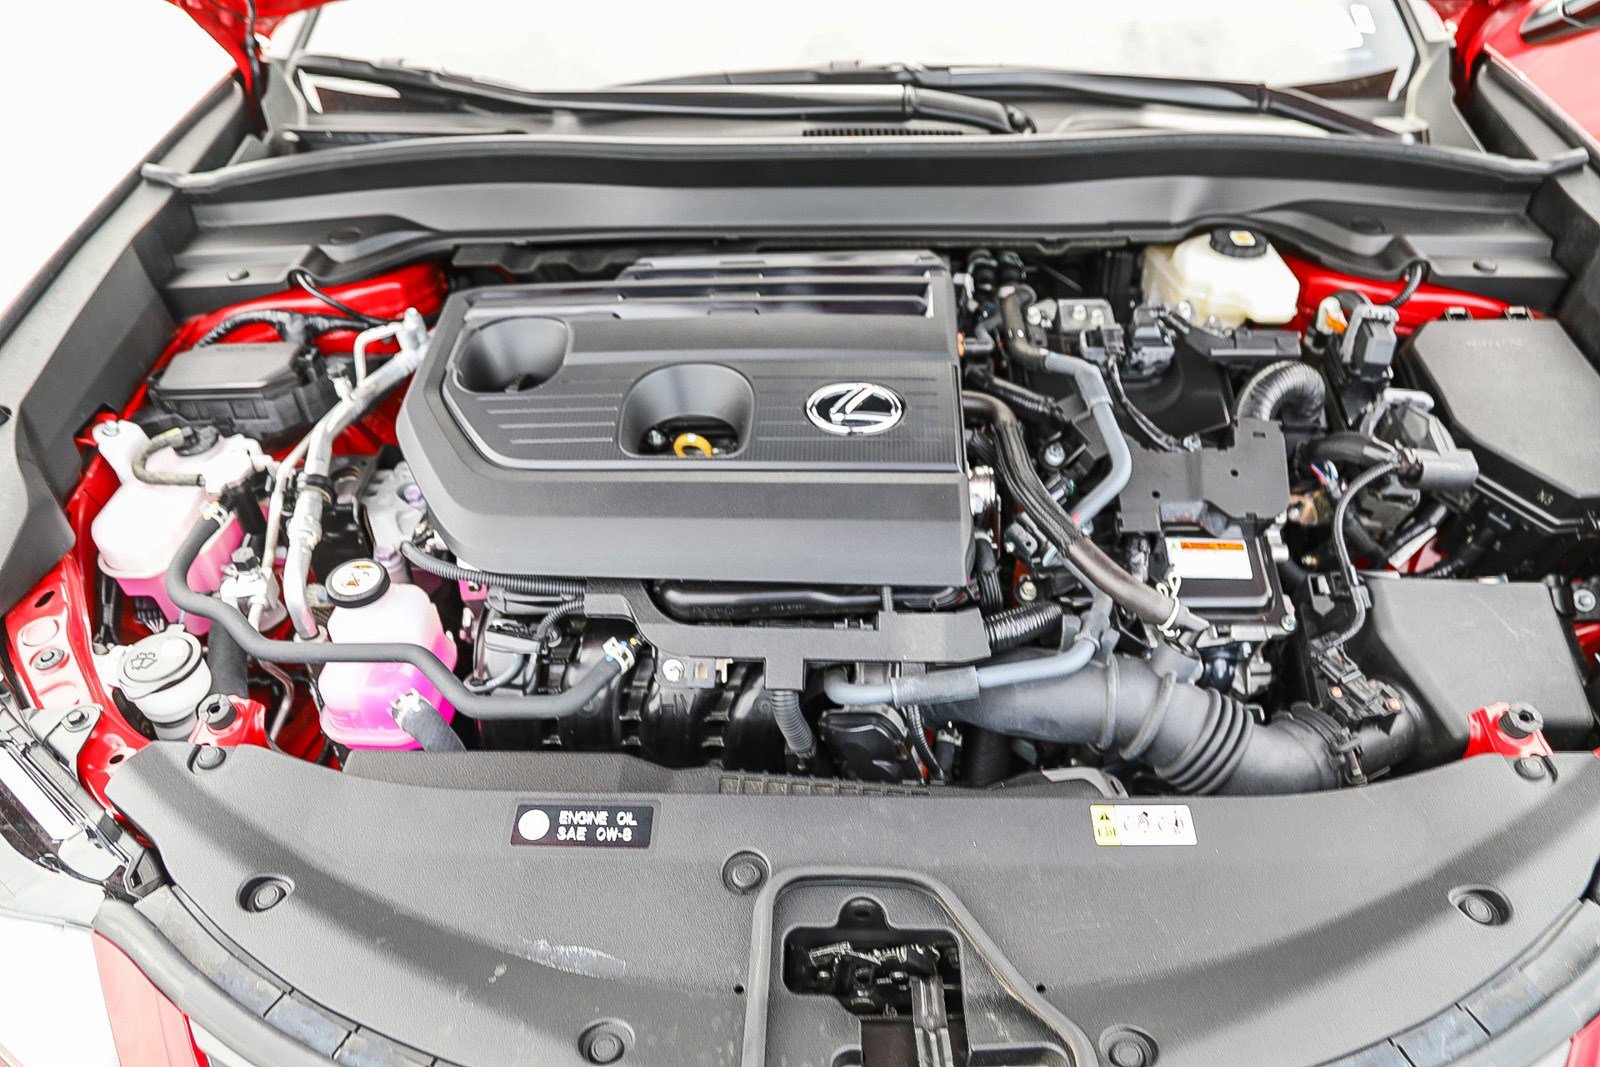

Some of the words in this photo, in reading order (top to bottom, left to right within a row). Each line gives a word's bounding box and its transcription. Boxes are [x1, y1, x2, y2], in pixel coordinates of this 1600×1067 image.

[558, 809, 609, 826] ENGINE
[616, 811, 638, 826] OIL
[556, 826, 587, 841] SAE
